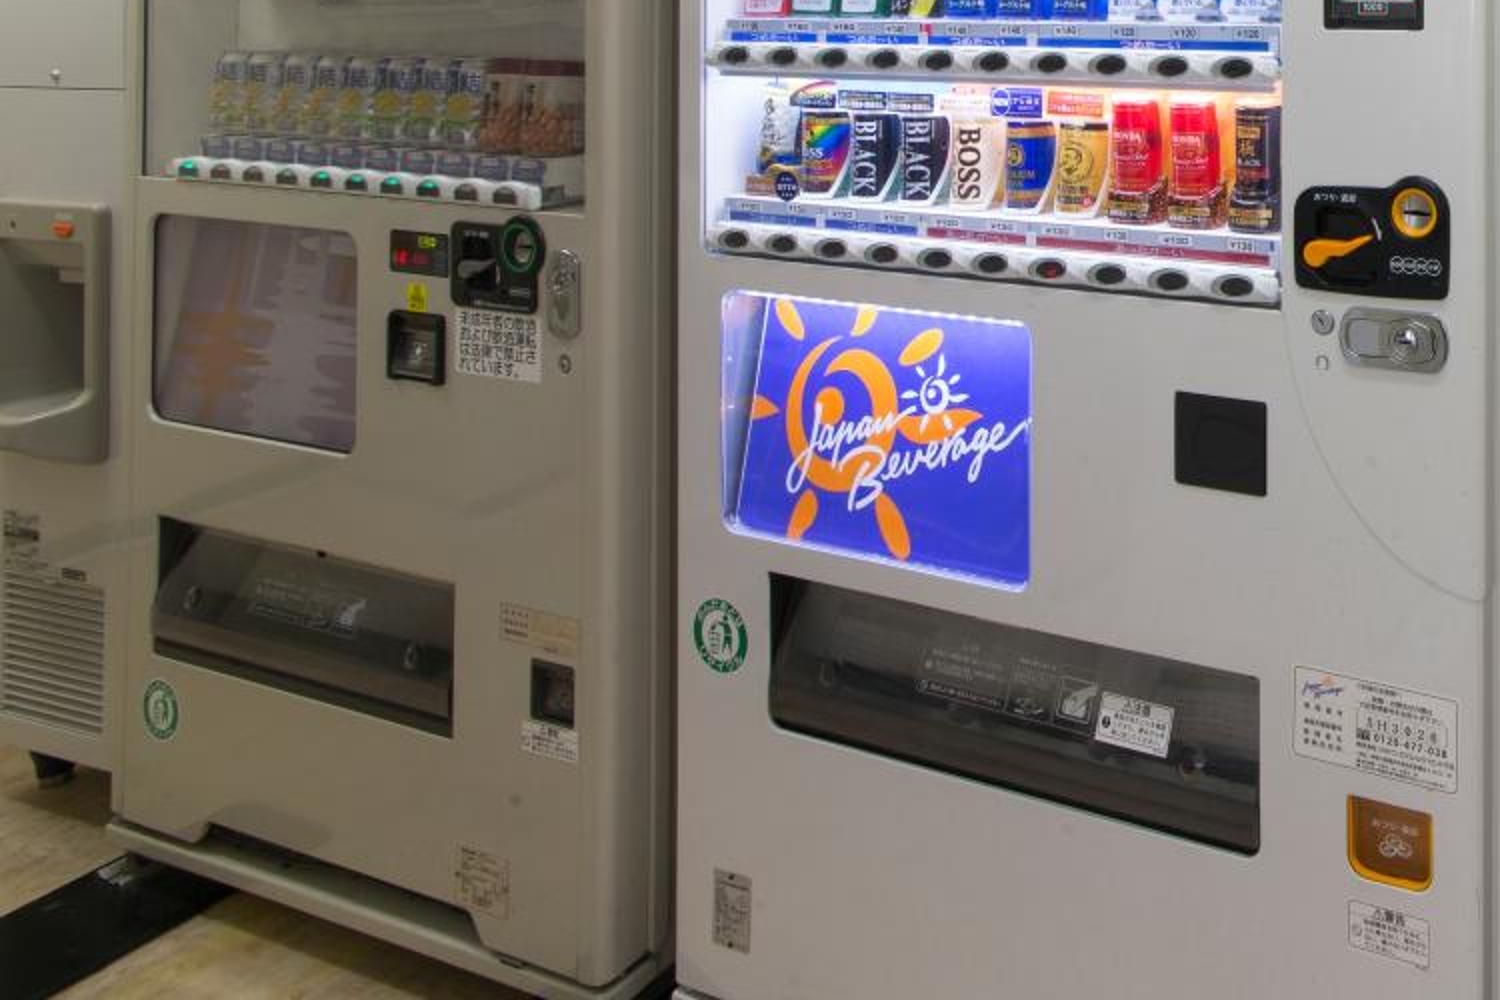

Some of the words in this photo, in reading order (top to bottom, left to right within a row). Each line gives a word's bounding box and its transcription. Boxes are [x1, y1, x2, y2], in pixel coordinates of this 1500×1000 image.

[853, 121, 877, 196] BLACK
[905, 121, 932, 200] BLACK
[957, 127, 981, 200] BOSS
[785, 404, 916, 493] Japan
[842, 417, 1031, 512] Beverage
